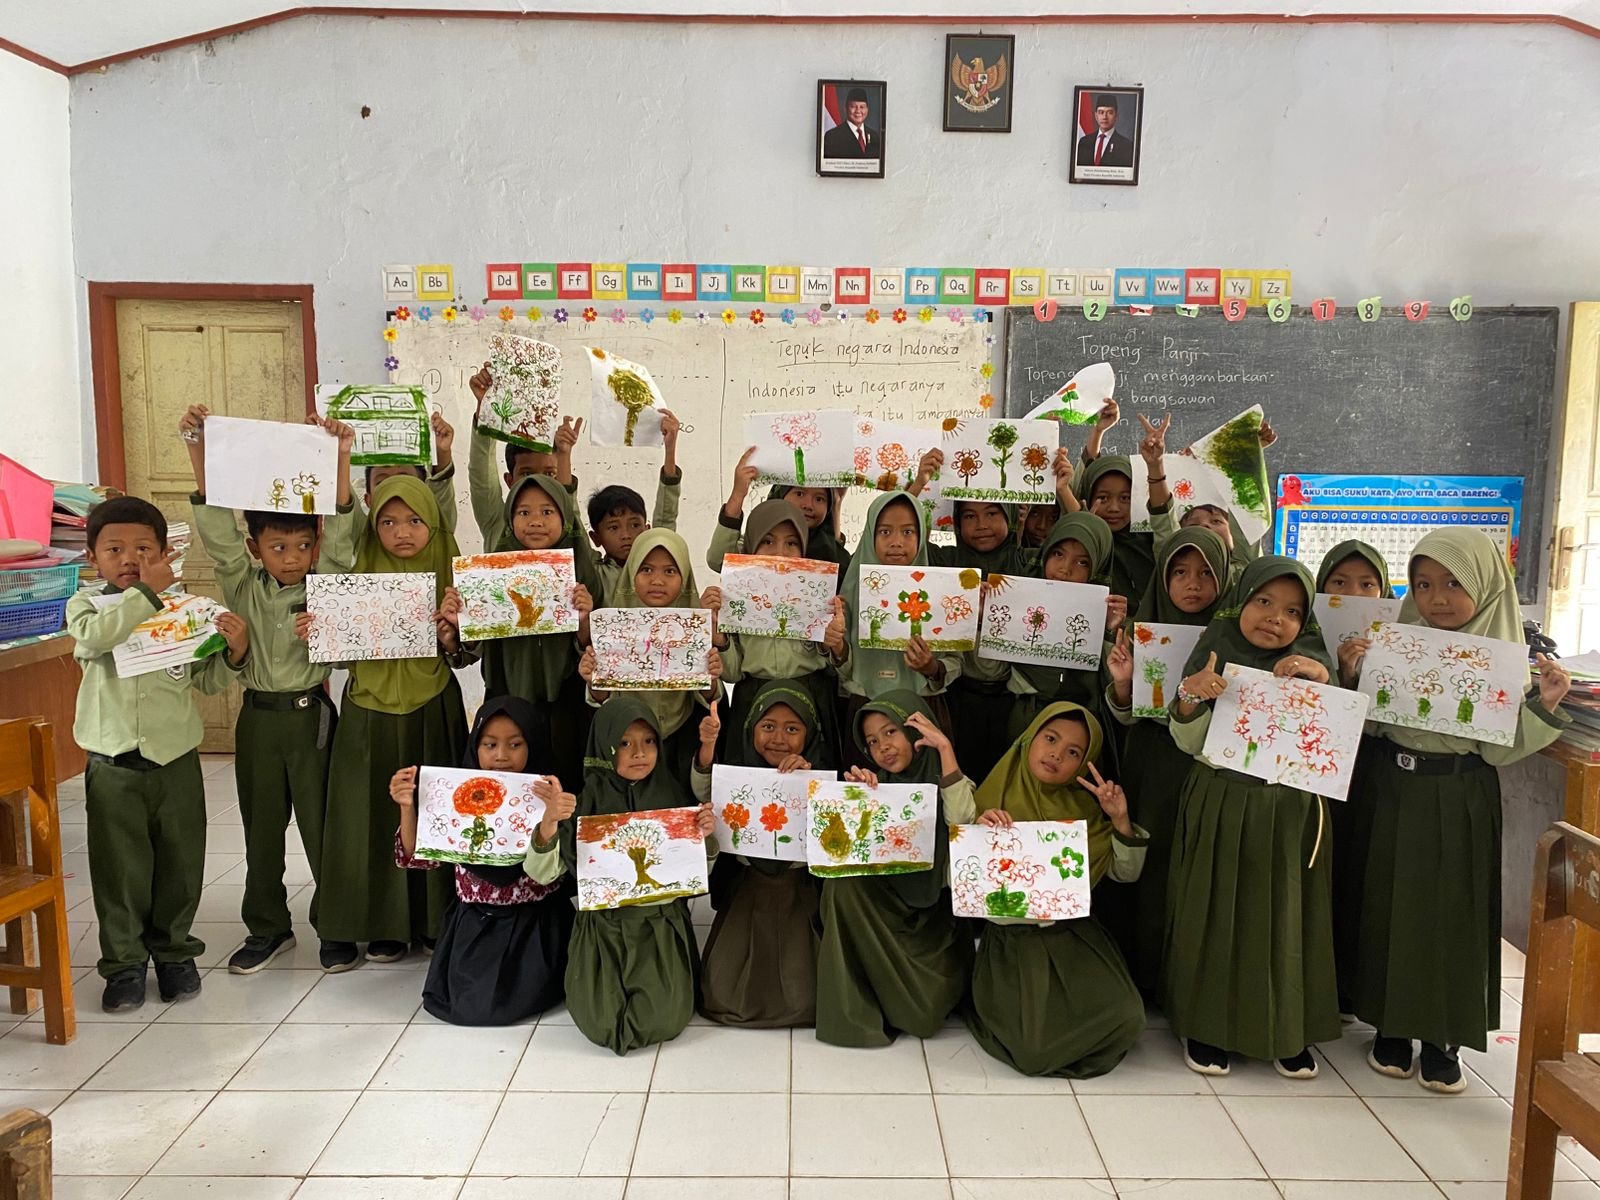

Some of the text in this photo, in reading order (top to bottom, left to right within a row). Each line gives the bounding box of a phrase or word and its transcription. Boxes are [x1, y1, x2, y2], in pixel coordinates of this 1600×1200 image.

[393, 274, 1280, 295] Aa Bb Dd Ee Ff Gg Hh Ii Jj Kk Ll Mm Nn Oo Pp Qq Rr Ss Tt Uu Vv Ww Xx Yy Zz
[1039, 301, 1471, 319] 1 2 5 6 7 8 9 10
[775, 337, 960, 367] Tepuk negara Indonesia
[1077, 334, 1199, 367] Topeng Panji
[1143, 370, 1268, 387] menggambarkan
[747, 379, 946, 403] Indonesia itu negaranya
[1131, 390, 1216, 409] bangsawan
[1303, 488, 1498, 498] AKU BISA SUKU KATA, AYO KITA BACA BARENG!
